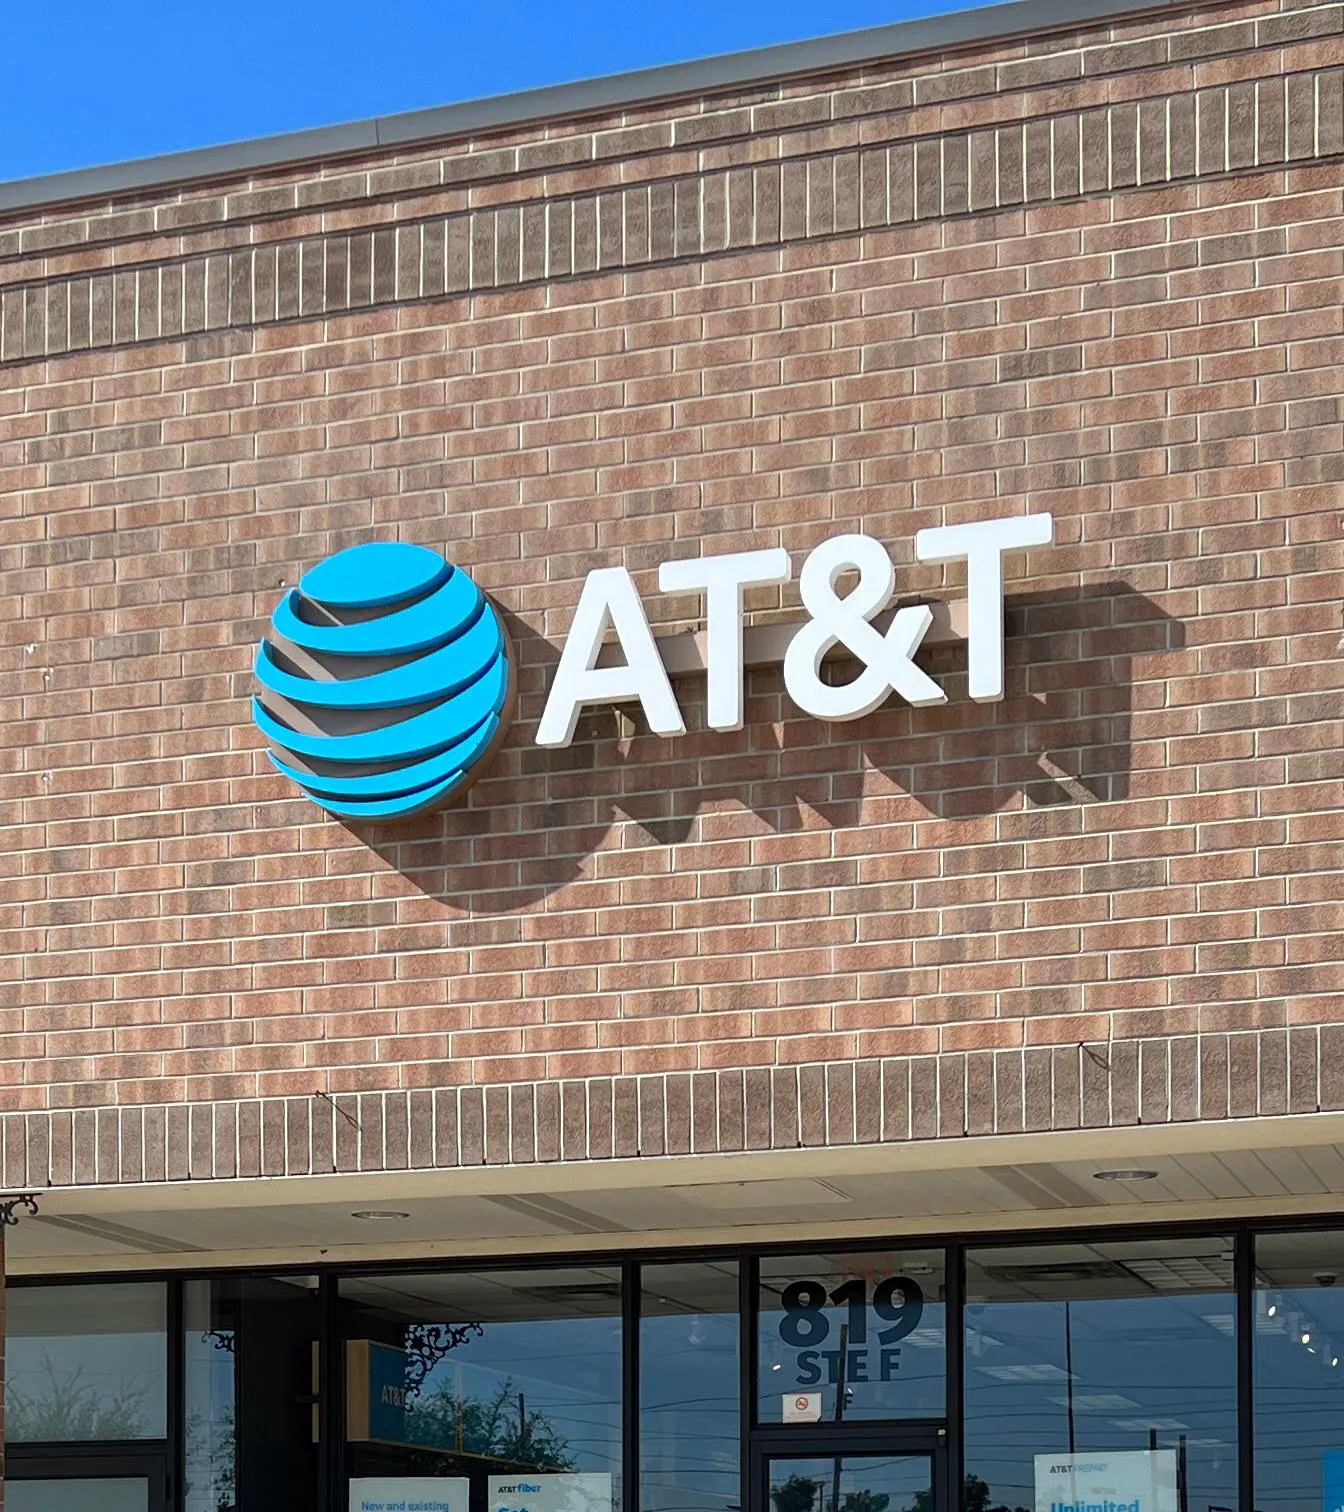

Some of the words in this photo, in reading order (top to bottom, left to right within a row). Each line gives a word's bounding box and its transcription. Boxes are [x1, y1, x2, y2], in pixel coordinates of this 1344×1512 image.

[535, 512, 1052, 749] AT&T
[779, 1276, 923, 1347] 819
[795, 1350, 868, 1385] STE
[880, 1349, 902, 1382] F
[381, 1384, 406, 1407] AT&T
[1050, 1465, 1073, 1474] AT&T
[498, 1486, 517, 1494] AT&T
[517, 1484, 541, 1493] fiber
[361, 1502, 384, 1511] New
[386, 1501, 406, 1511] and
[408, 1500, 449, 1512] existing
